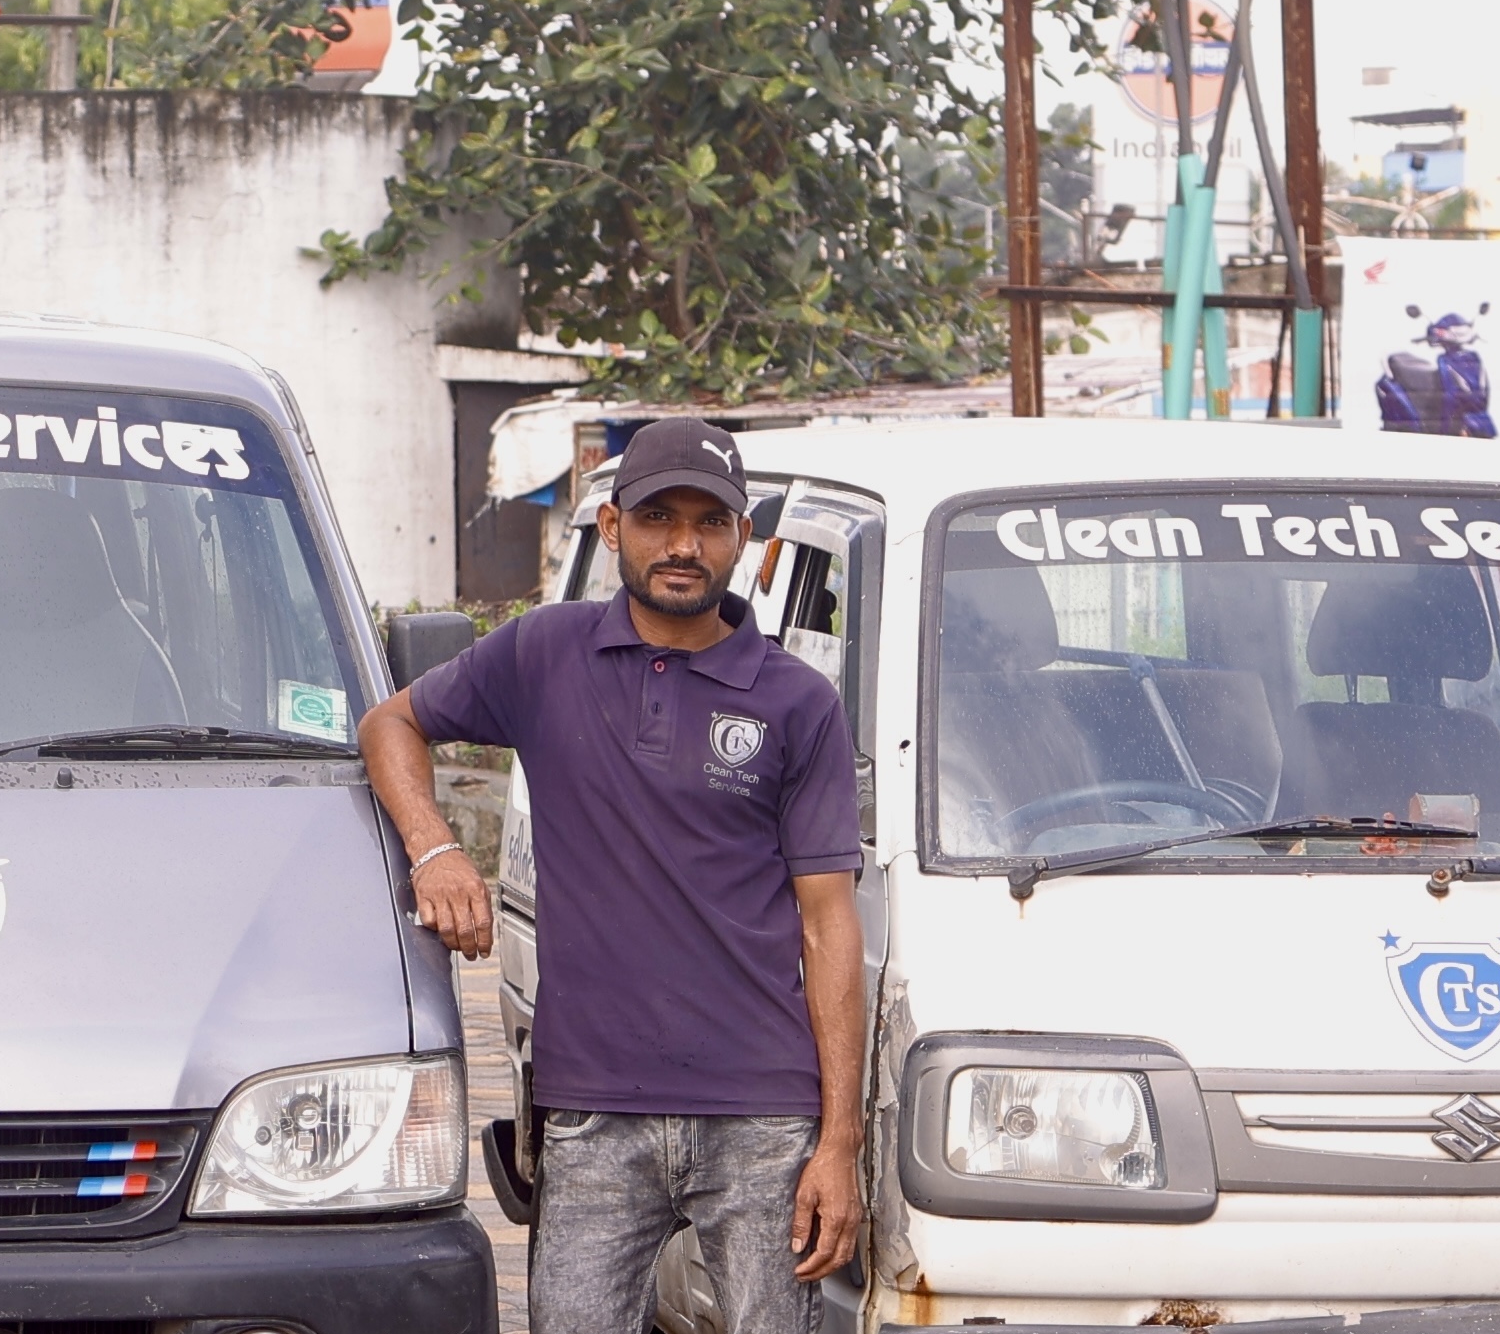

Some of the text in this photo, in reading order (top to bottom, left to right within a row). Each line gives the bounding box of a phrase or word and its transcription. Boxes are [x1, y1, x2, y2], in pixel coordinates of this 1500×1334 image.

[1000, 506, 1203, 561] Clean
[1221, 504, 1400, 558] Tech
[720, 724, 754, 756] CTS
[703, 762, 760, 785] Clean Tech
[708, 778, 751, 797] Services
